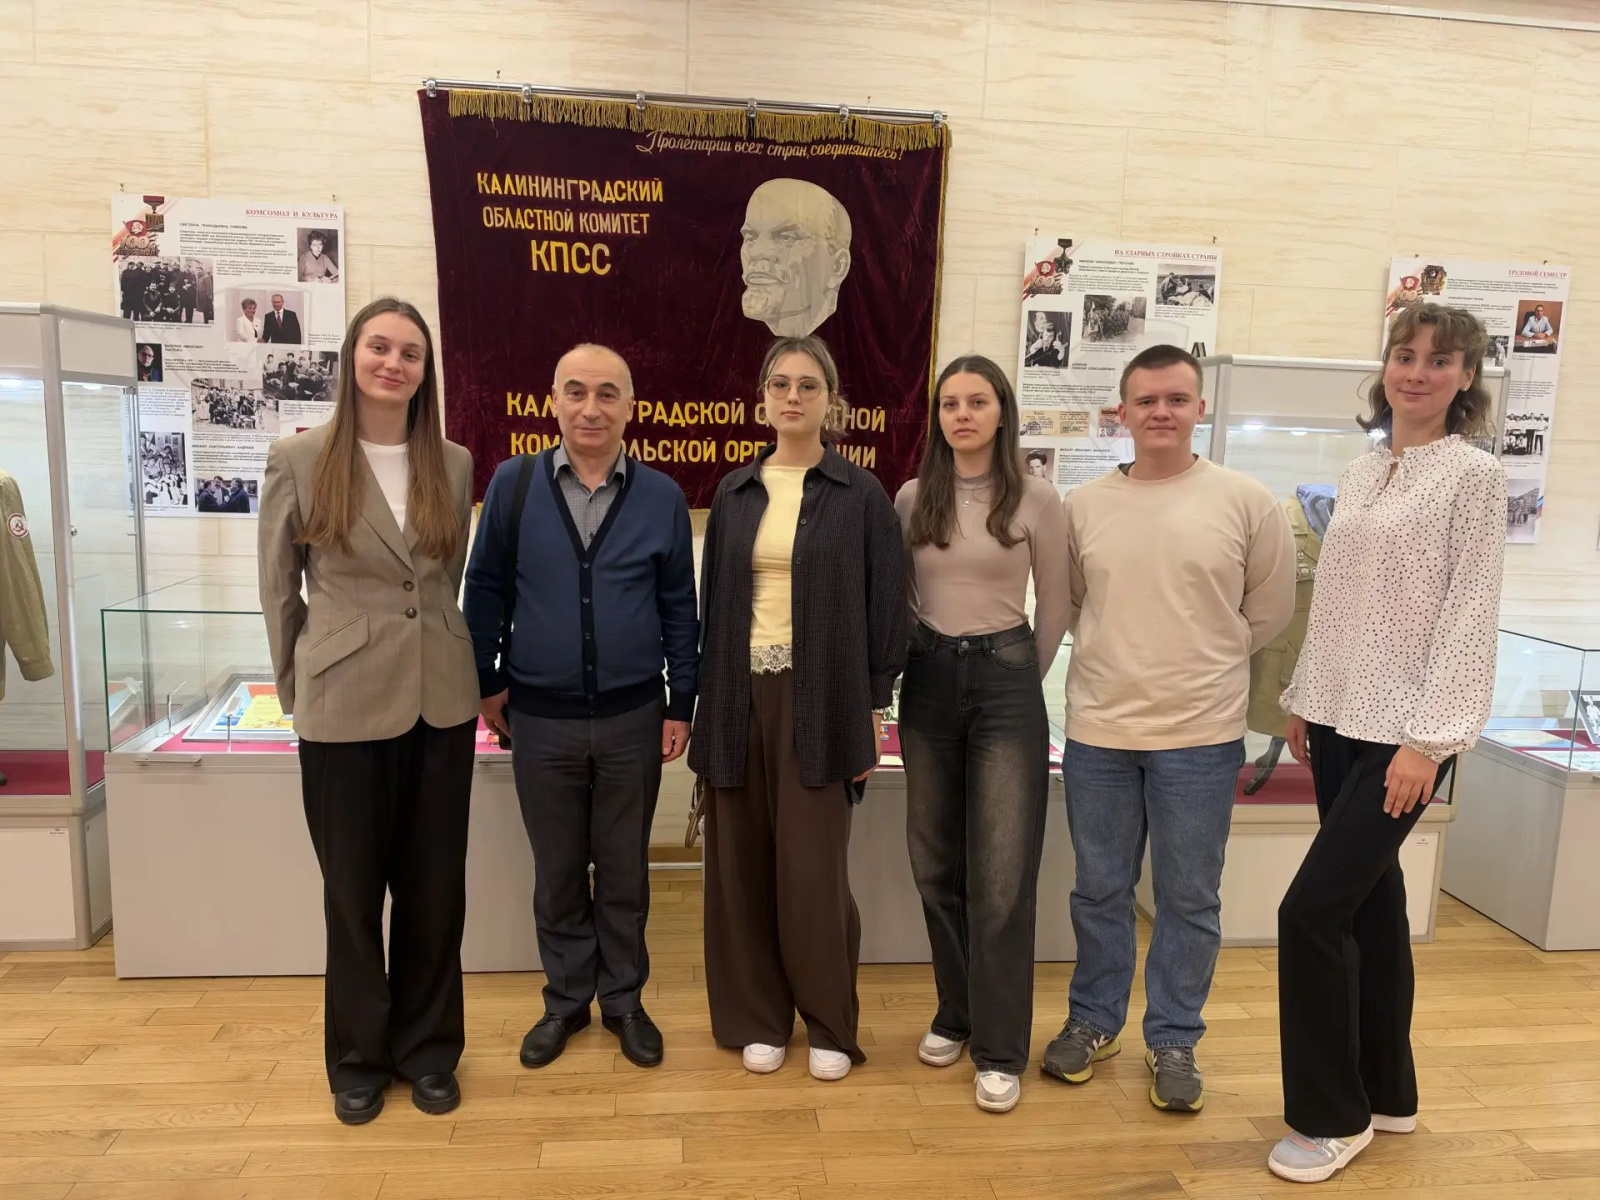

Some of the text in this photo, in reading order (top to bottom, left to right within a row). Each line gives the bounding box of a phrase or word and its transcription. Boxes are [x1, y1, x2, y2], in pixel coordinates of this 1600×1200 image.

[635, 129, 731, 156] Пролетарии
[735, 141, 763, 154] всех
[767, 144, 809, 160] стран,
[477, 172, 663, 204] КАЛИНИНГРАДСКИЙ
[245, 208, 290, 217] КОМСОМОЛ
[302, 211, 338, 219] КУЛЬТУРА
[482, 206, 650, 234] ОБЛАСТНОЙ КОМИТЕТ
[530, 239, 611, 275] КПСС
[506, 391, 745, 427] КАЛРАДСКОЙ
